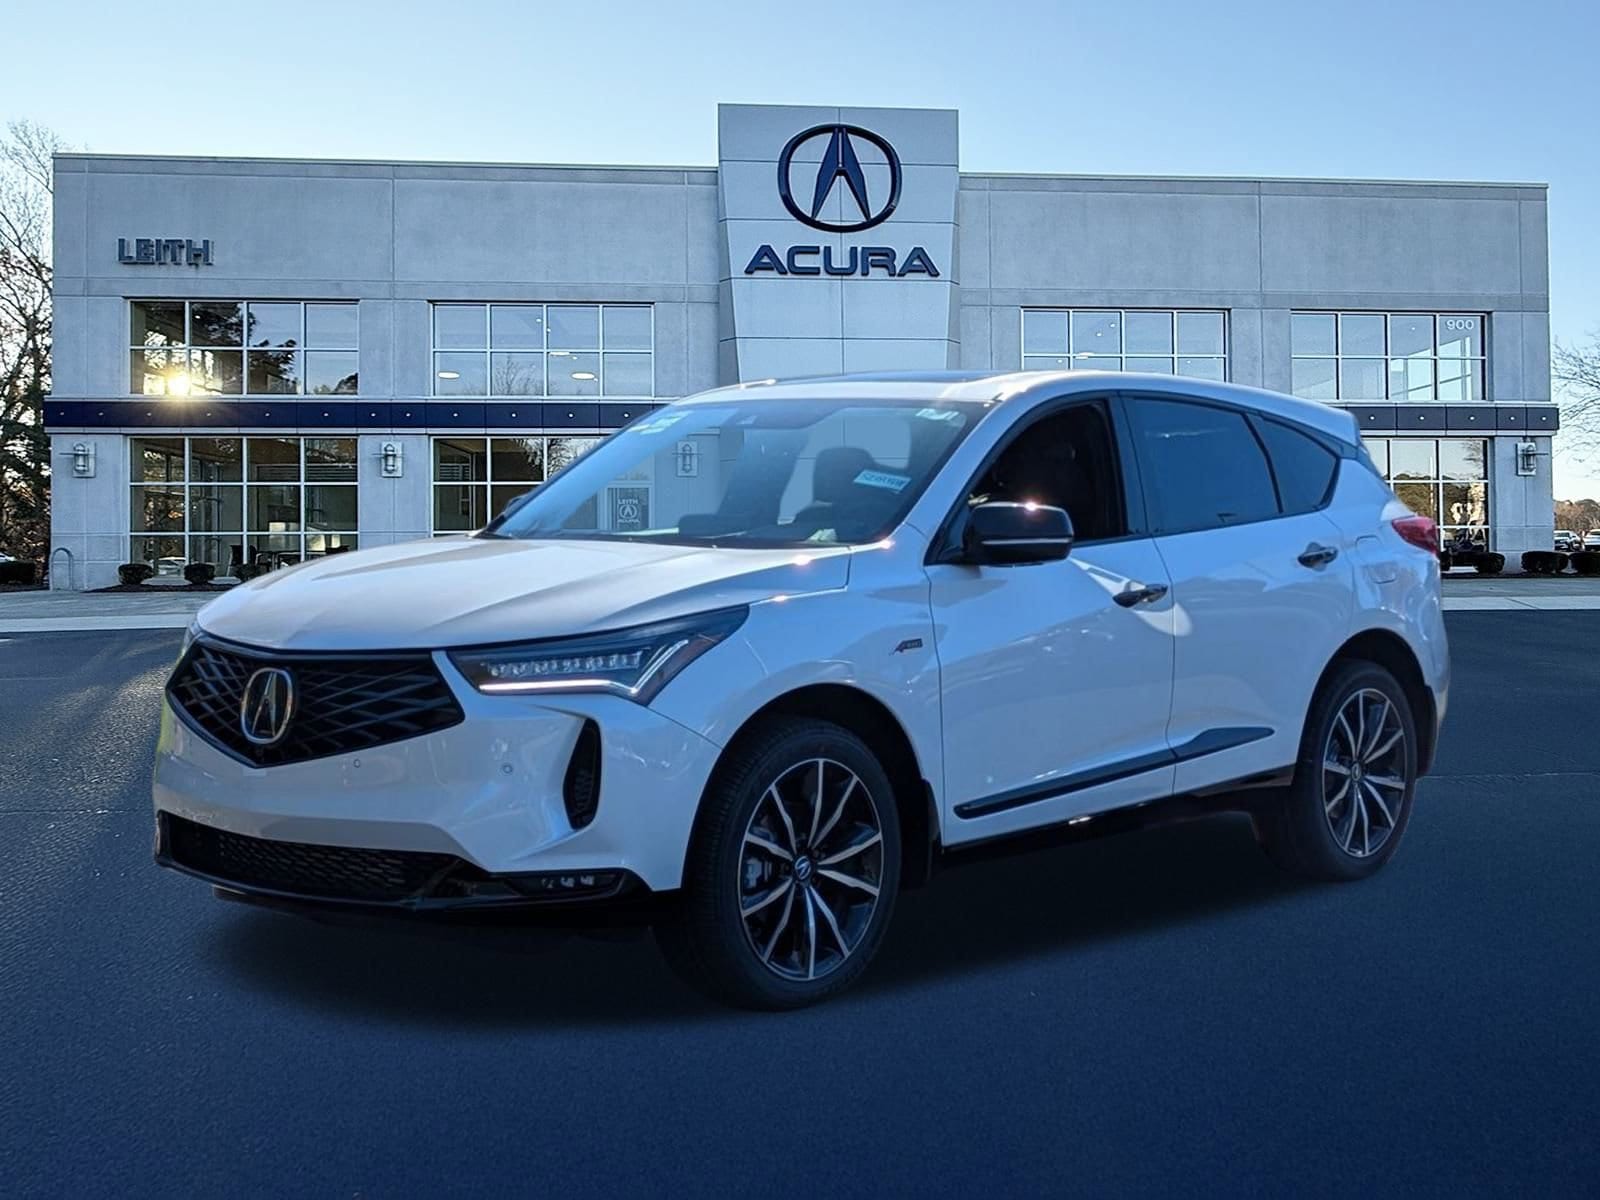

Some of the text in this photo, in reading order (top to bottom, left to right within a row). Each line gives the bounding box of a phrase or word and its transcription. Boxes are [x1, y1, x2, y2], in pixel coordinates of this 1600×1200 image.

[117, 238, 213, 265] LEITH
[744, 244, 941, 278] ACURA
[1446, 319, 1474, 330] 900
